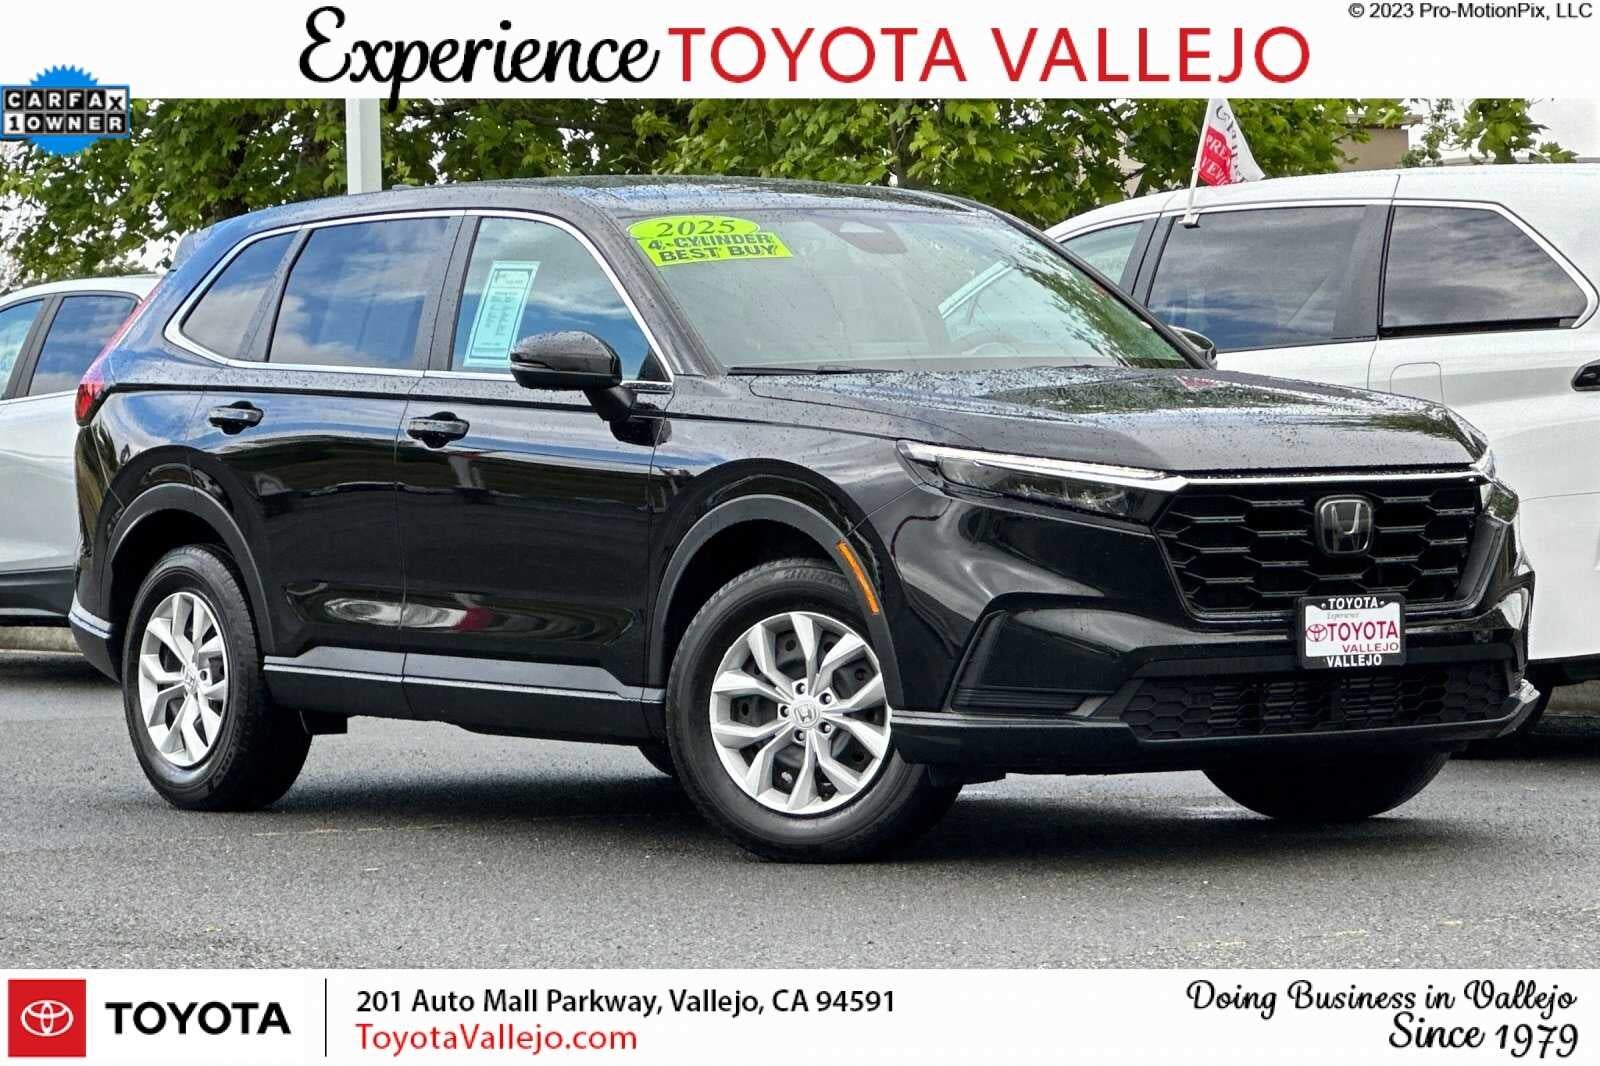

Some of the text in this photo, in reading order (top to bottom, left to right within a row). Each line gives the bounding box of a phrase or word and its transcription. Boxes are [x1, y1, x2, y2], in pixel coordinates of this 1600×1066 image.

[656, 220, 735, 237] 2025
[648, 233, 772, 250] 4-CYLINDER
[659, 244, 777, 262] BEST BUY
[1328, 597, 1378, 610] TOYOTA
[1327, 621, 1398, 641] TOYOTA
[1342, 642, 1399, 653] VALLEJO
[1327, 654, 1382, 668] VALLEJO
